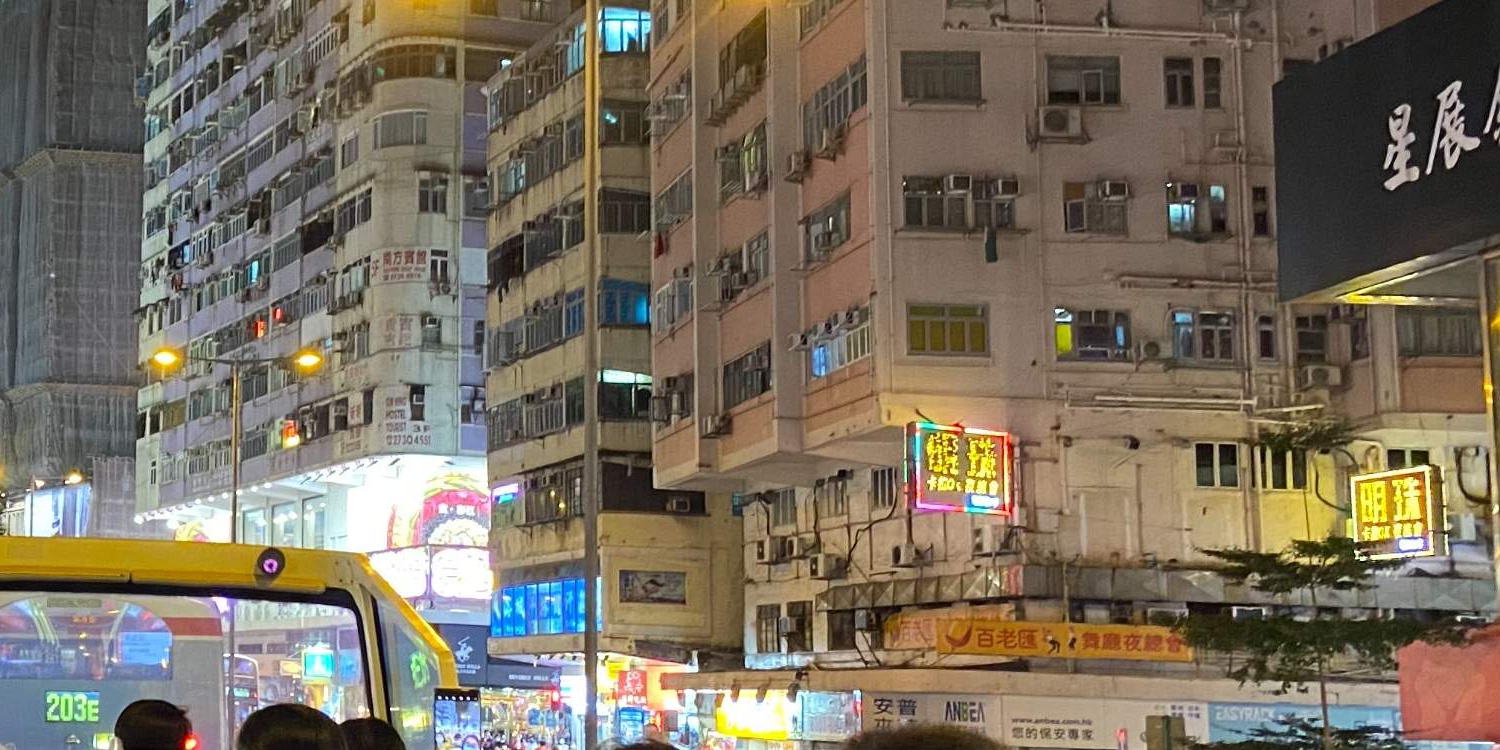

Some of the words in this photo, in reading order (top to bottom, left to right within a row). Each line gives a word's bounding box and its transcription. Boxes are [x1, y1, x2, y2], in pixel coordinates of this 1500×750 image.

[976, 628, 1039, 649] 百老匯
[46, 693, 99, 722] 203E
[873, 698, 917, 716] 安普
[1011, 728, 1094, 742] 您的保安專家
